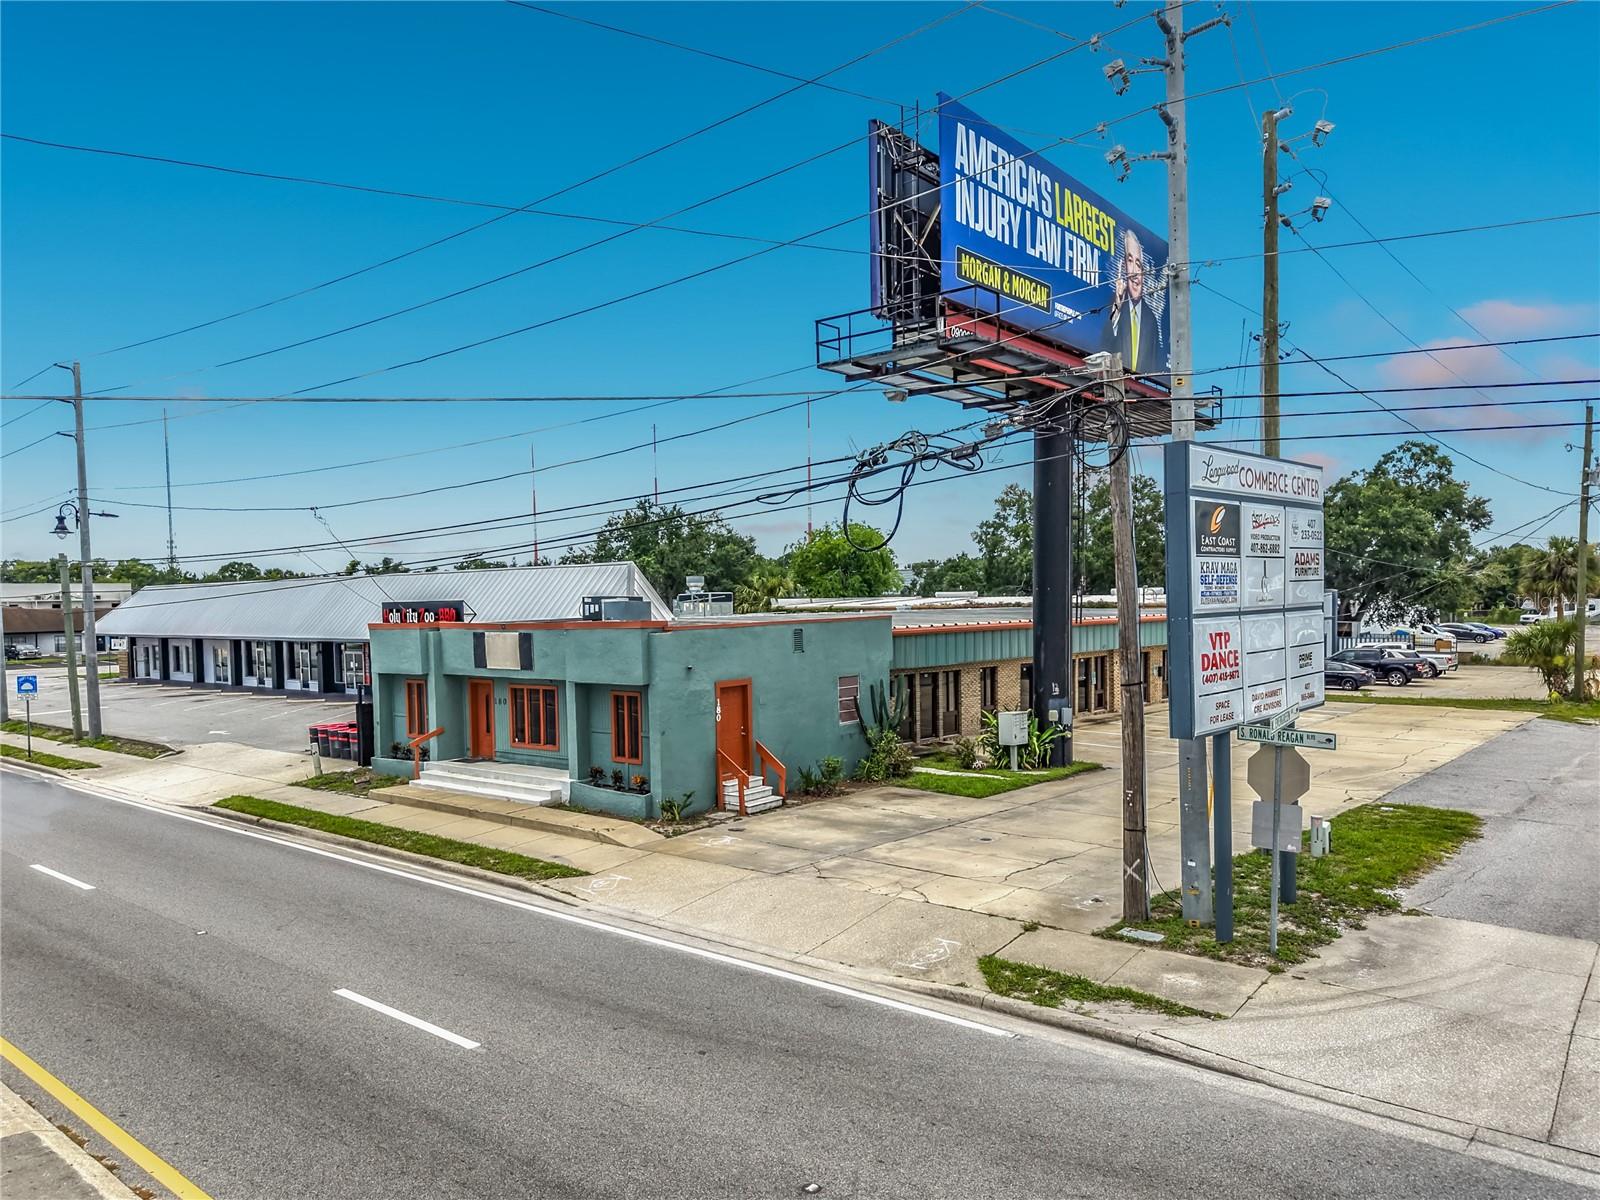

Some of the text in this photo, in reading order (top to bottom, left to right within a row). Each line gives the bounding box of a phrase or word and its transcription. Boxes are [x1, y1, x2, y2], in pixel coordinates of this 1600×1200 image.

[955, 122, 1115, 256] AMERICA'S LARGEST
[956, 174, 1099, 288] INJURY LAW FIRM
[961, 253, 1048, 308] MORGAN & MORGAN
[1202, 455, 1320, 498] Longwood COMMERCE CENTER
[1294, 553, 1320, 566] ADAMS
[1200, 562, 1237, 574] KRAV MAGA
[1295, 567, 1319, 576] FURNITURE
[1200, 574, 1237, 585] SELF-DEFENSE
[1209, 632, 1230, 650] VTP
[1201, 650, 1239, 672] DANCE
[1202, 673, 1218, 685] (407)
[1216, 700, 1230, 710] SPACE
[1254, 700, 1281, 714] CRE ADVISORS
[1210, 712, 1234, 724] FOR LEASE
[1240, 727, 1246, 738] S.
[1250, 729, 1275, 740] RONALD
[1278, 730, 1304, 744] REAGAN
